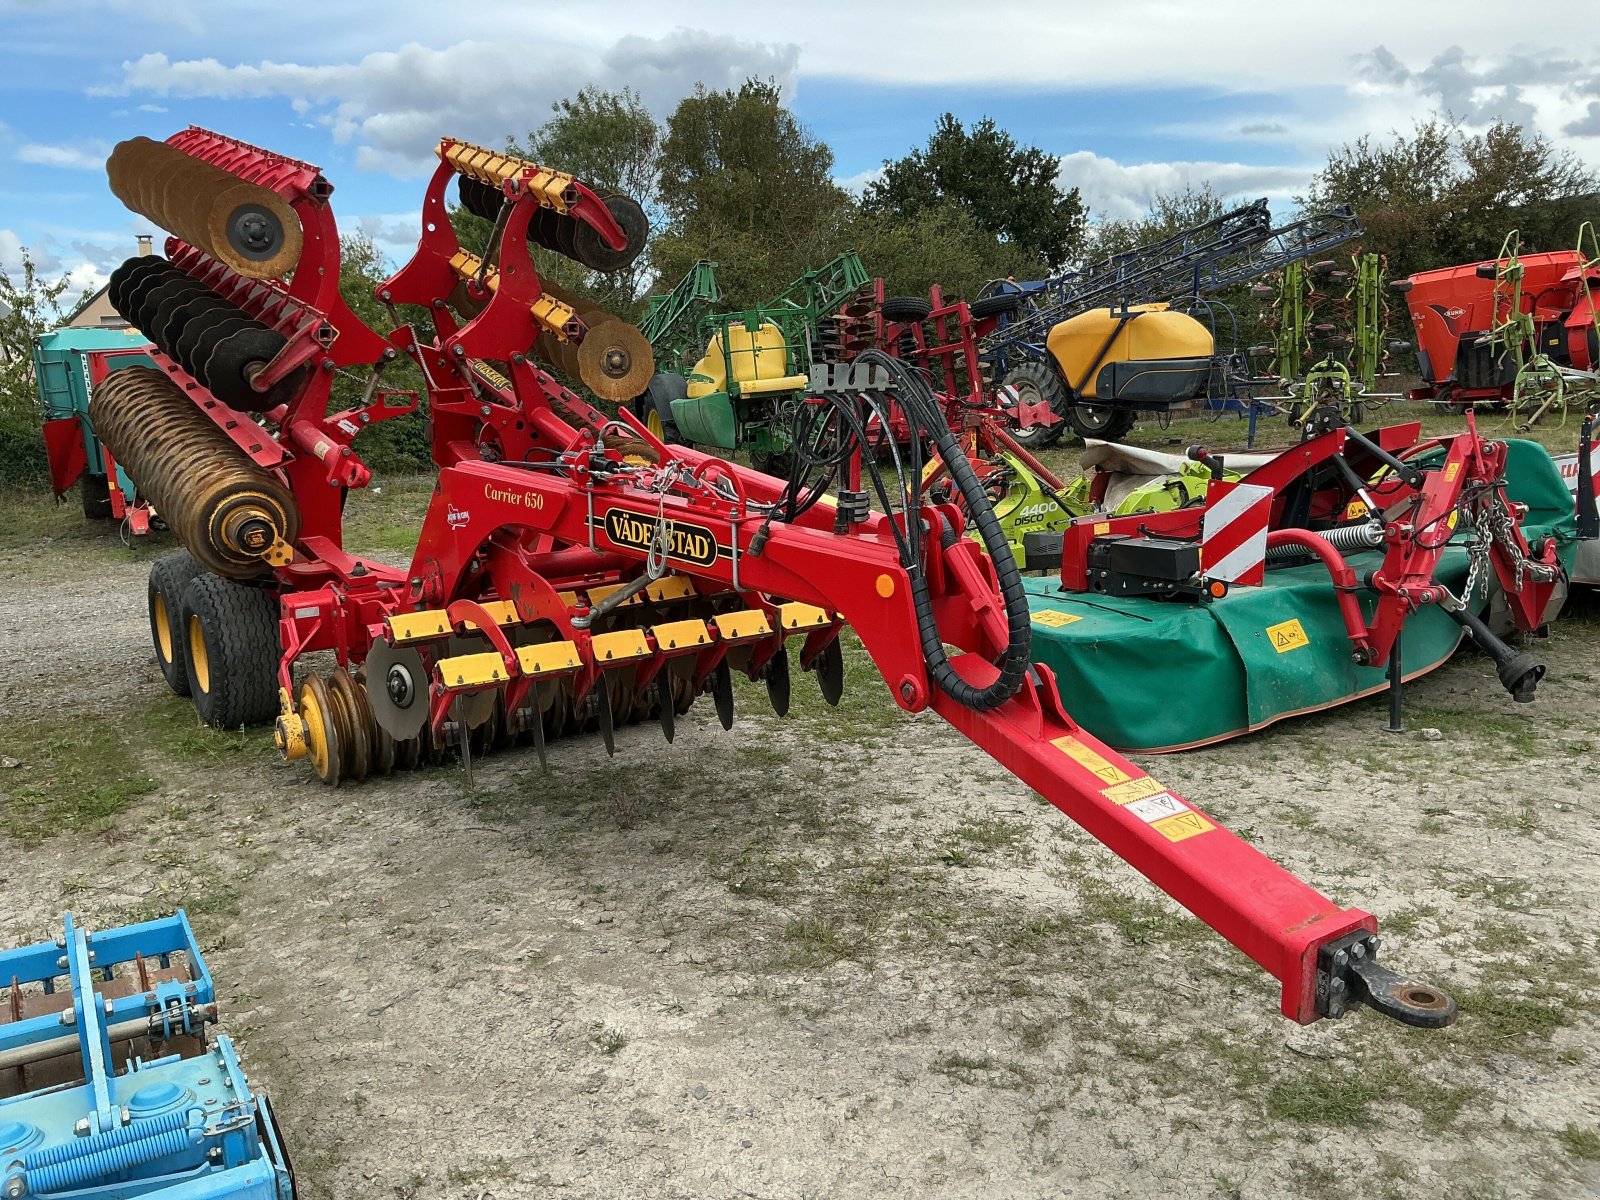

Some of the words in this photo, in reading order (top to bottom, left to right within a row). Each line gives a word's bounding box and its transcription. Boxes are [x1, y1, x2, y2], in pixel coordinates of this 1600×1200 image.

[484, 483, 522, 505] Carrier
[524, 491, 544, 510] 650
[1019, 501, 1059, 516] 4400
[1014, 513, 1044, 526] DISCO
[611, 513, 709, 559] VÄDESTAD
